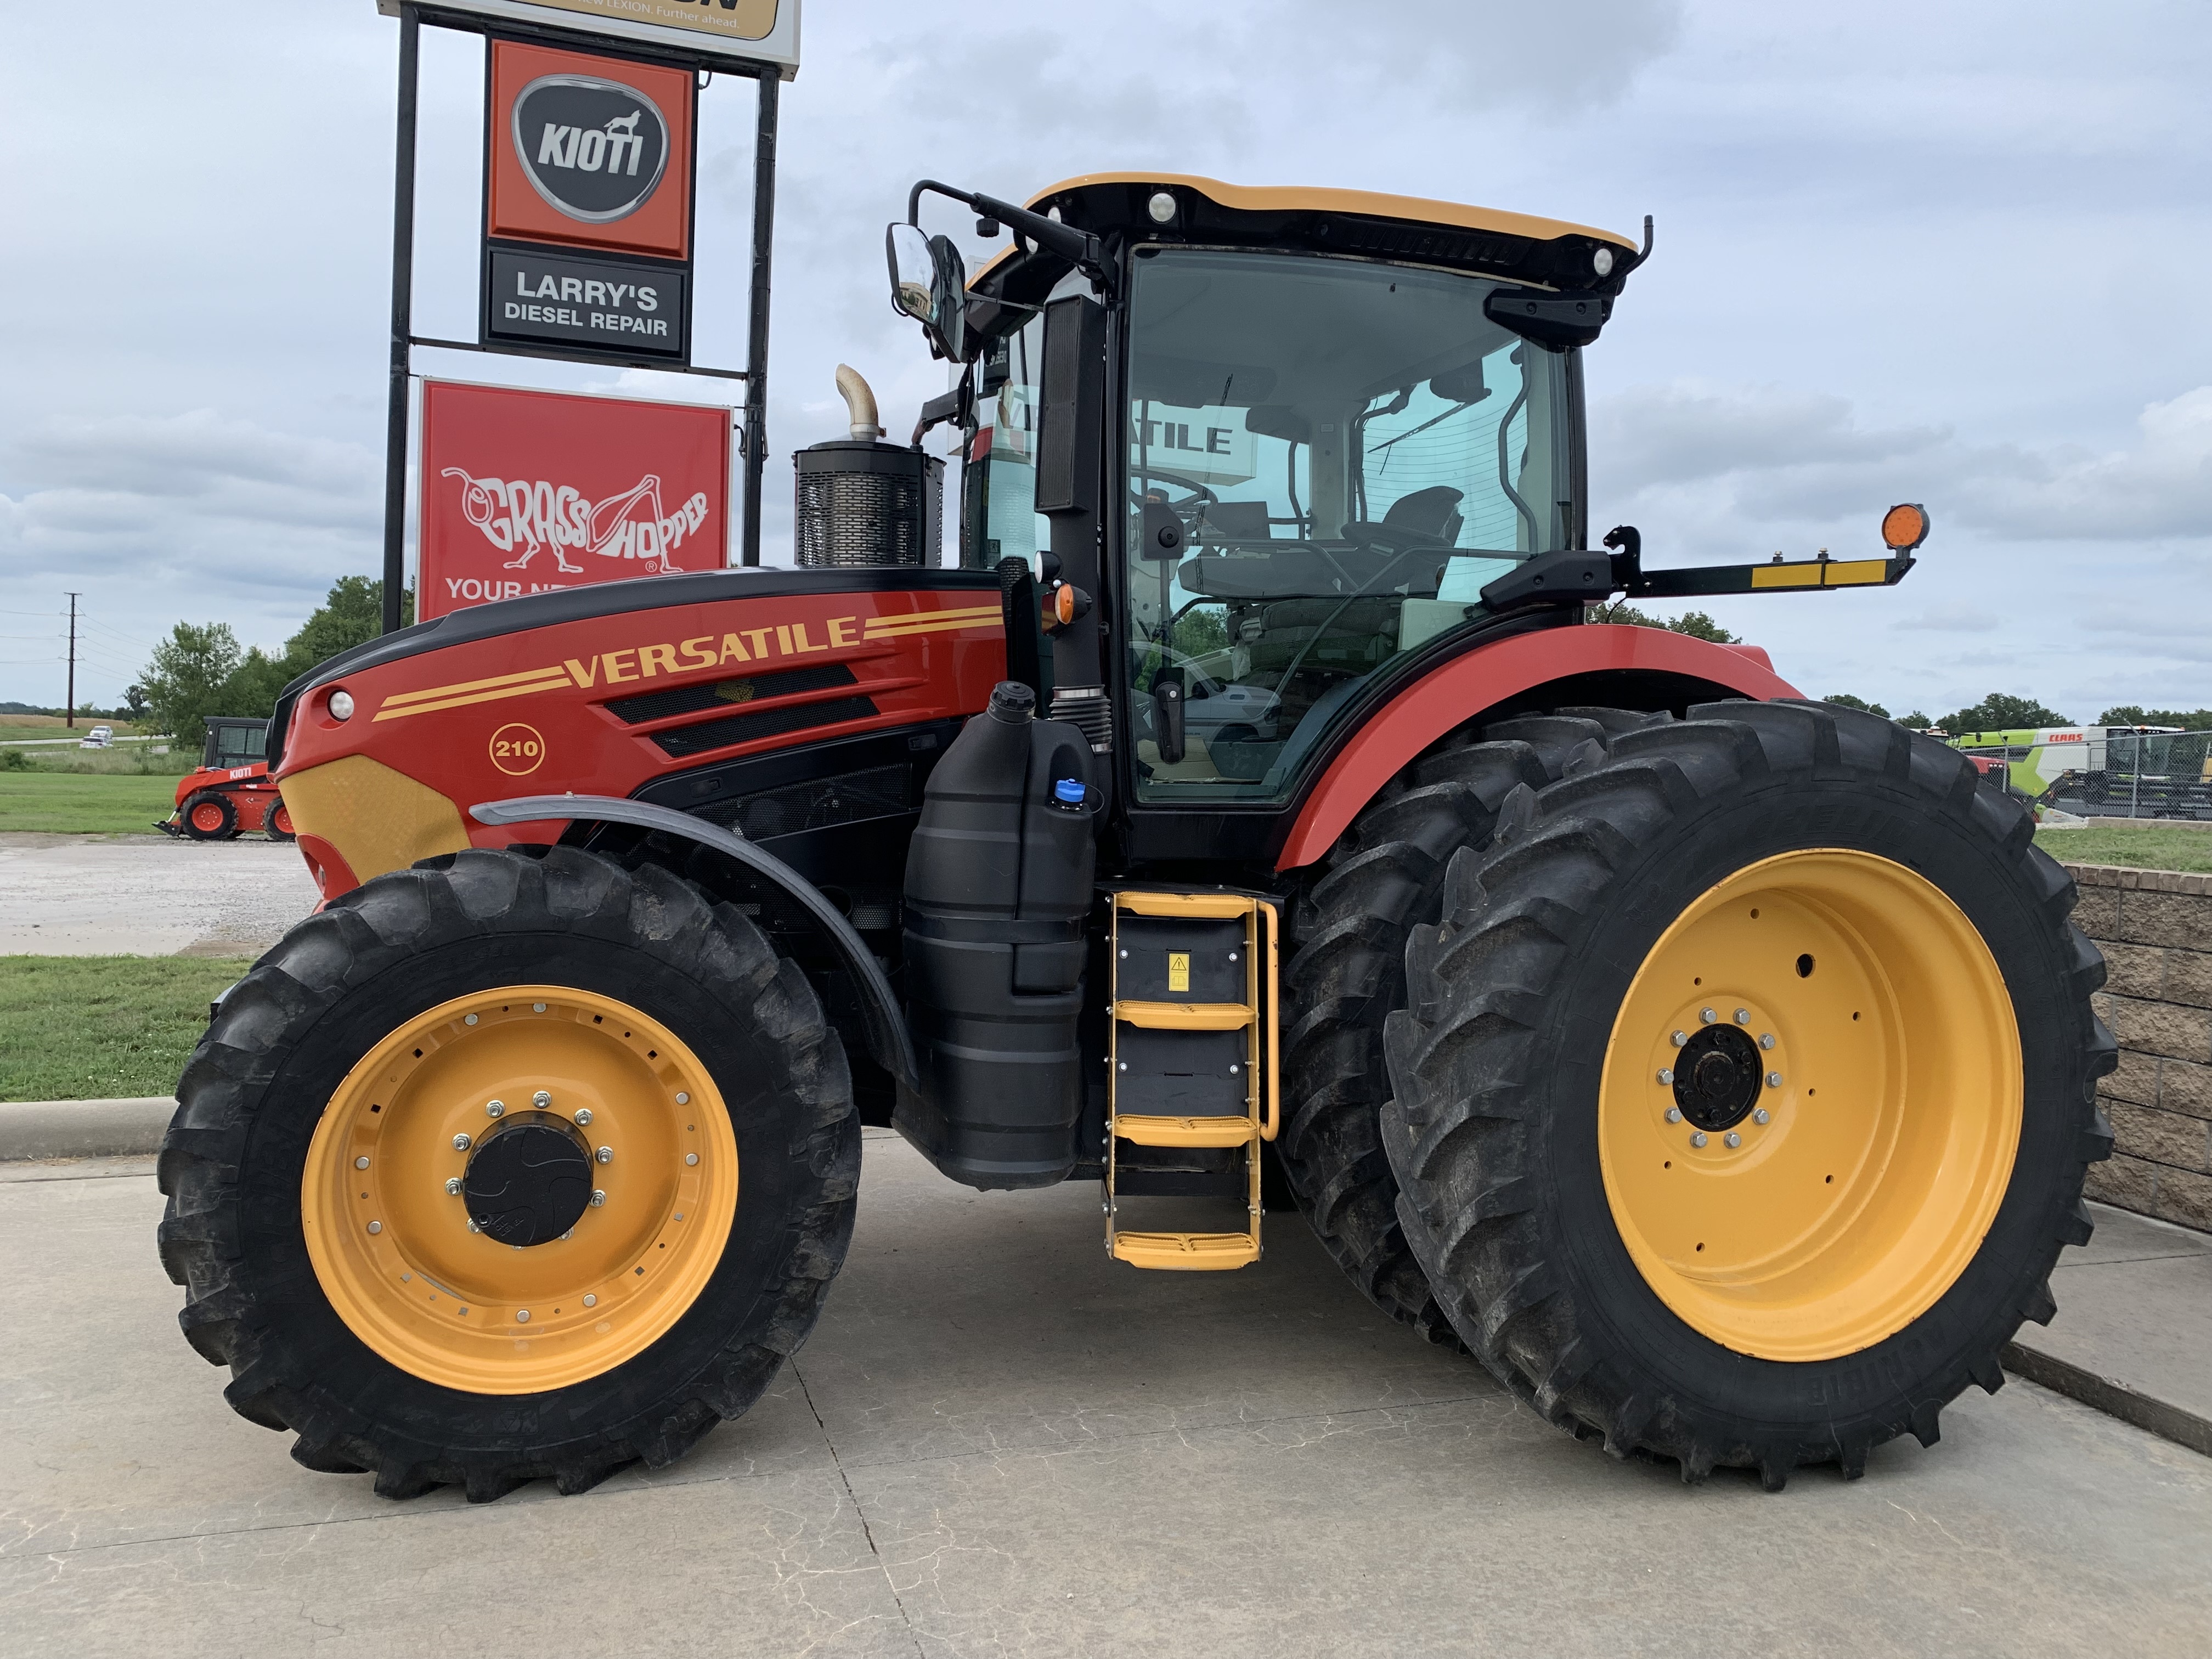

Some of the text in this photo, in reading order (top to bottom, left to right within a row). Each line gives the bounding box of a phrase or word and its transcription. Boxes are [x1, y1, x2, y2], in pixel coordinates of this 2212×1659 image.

[656, 5, 699, 21] Further
[702, 14, 740, 29] ahead.
[538, 122, 644, 176] KIOTI
[517, 272, 658, 311] LARRY'S
[505, 302, 667, 336] DIESEL REPAIR
[445, 578, 521, 601] YOUR
[563, 616, 860, 689] VERSATILE
[495, 741, 538, 757] 210
[2049, 733, 2083, 742] CLAAS
[229, 767, 252, 780] KIOTI
